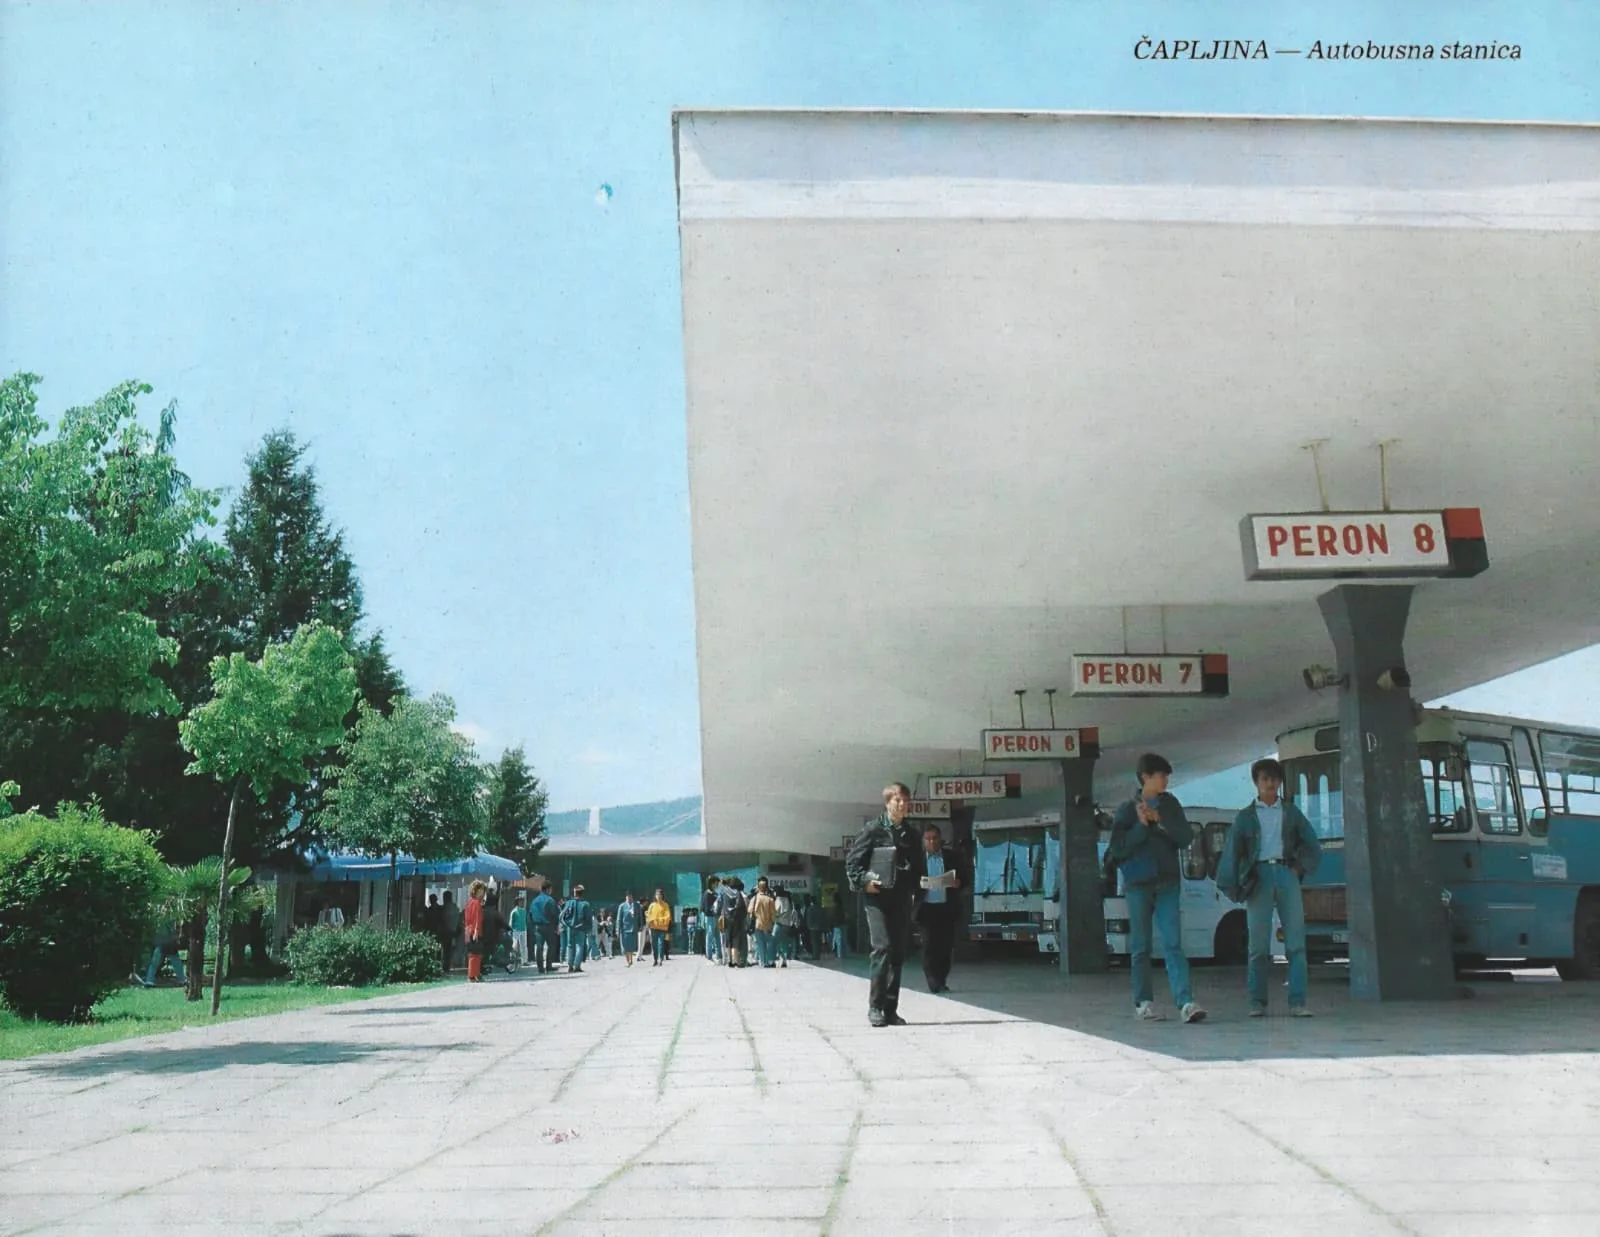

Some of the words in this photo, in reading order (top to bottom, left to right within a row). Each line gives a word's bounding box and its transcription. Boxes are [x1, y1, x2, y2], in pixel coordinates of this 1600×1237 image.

[1267, 523, 1389, 557] PERON
[1413, 523, 1436, 554] 8
[1081, 663, 1163, 685] PERON
[1178, 663, 1193, 685] 7
[991, 735, 1052, 753] PERON
[934, 780, 983, 795] PERON
[992, 779, 1002, 795] 5
